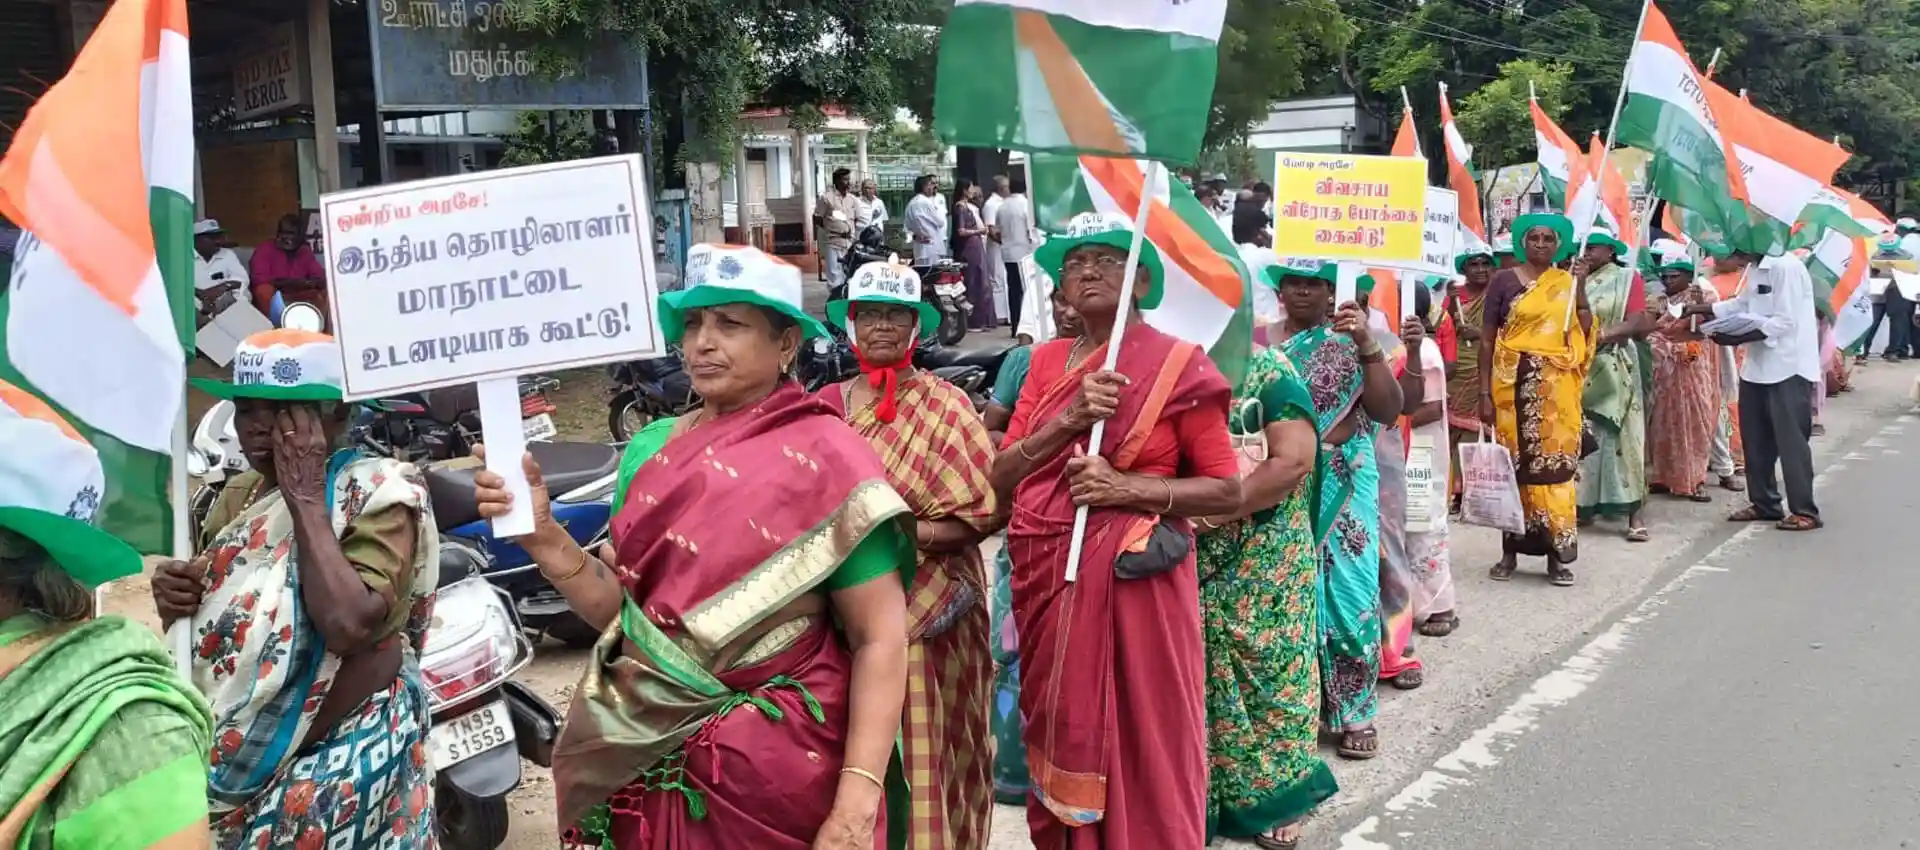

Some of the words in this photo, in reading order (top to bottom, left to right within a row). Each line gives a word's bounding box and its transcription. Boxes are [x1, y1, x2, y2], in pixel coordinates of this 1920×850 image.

[243, 77, 288, 112] XEROX
[1314, 176, 1390, 199] விவசாய
[336, 202, 412, 233] ஒன்றிய
[418, 190, 489, 216] அரசே!
[1281, 200, 1343, 222] விரோத
[336, 234, 438, 279] இந்திய
[445, 203, 632, 261] தொழிலாளர்
[1314, 226, 1386, 249] கைவிடு!
[397, 266, 583, 317] மாநாட்டை
[875, 280, 901, 296] INTUC
[361, 322, 531, 372] உடனடியாக
[539, 301, 632, 345] கூட்டு!
[447, 708, 495, 739] TN99
[448, 725, 505, 760] S1559
